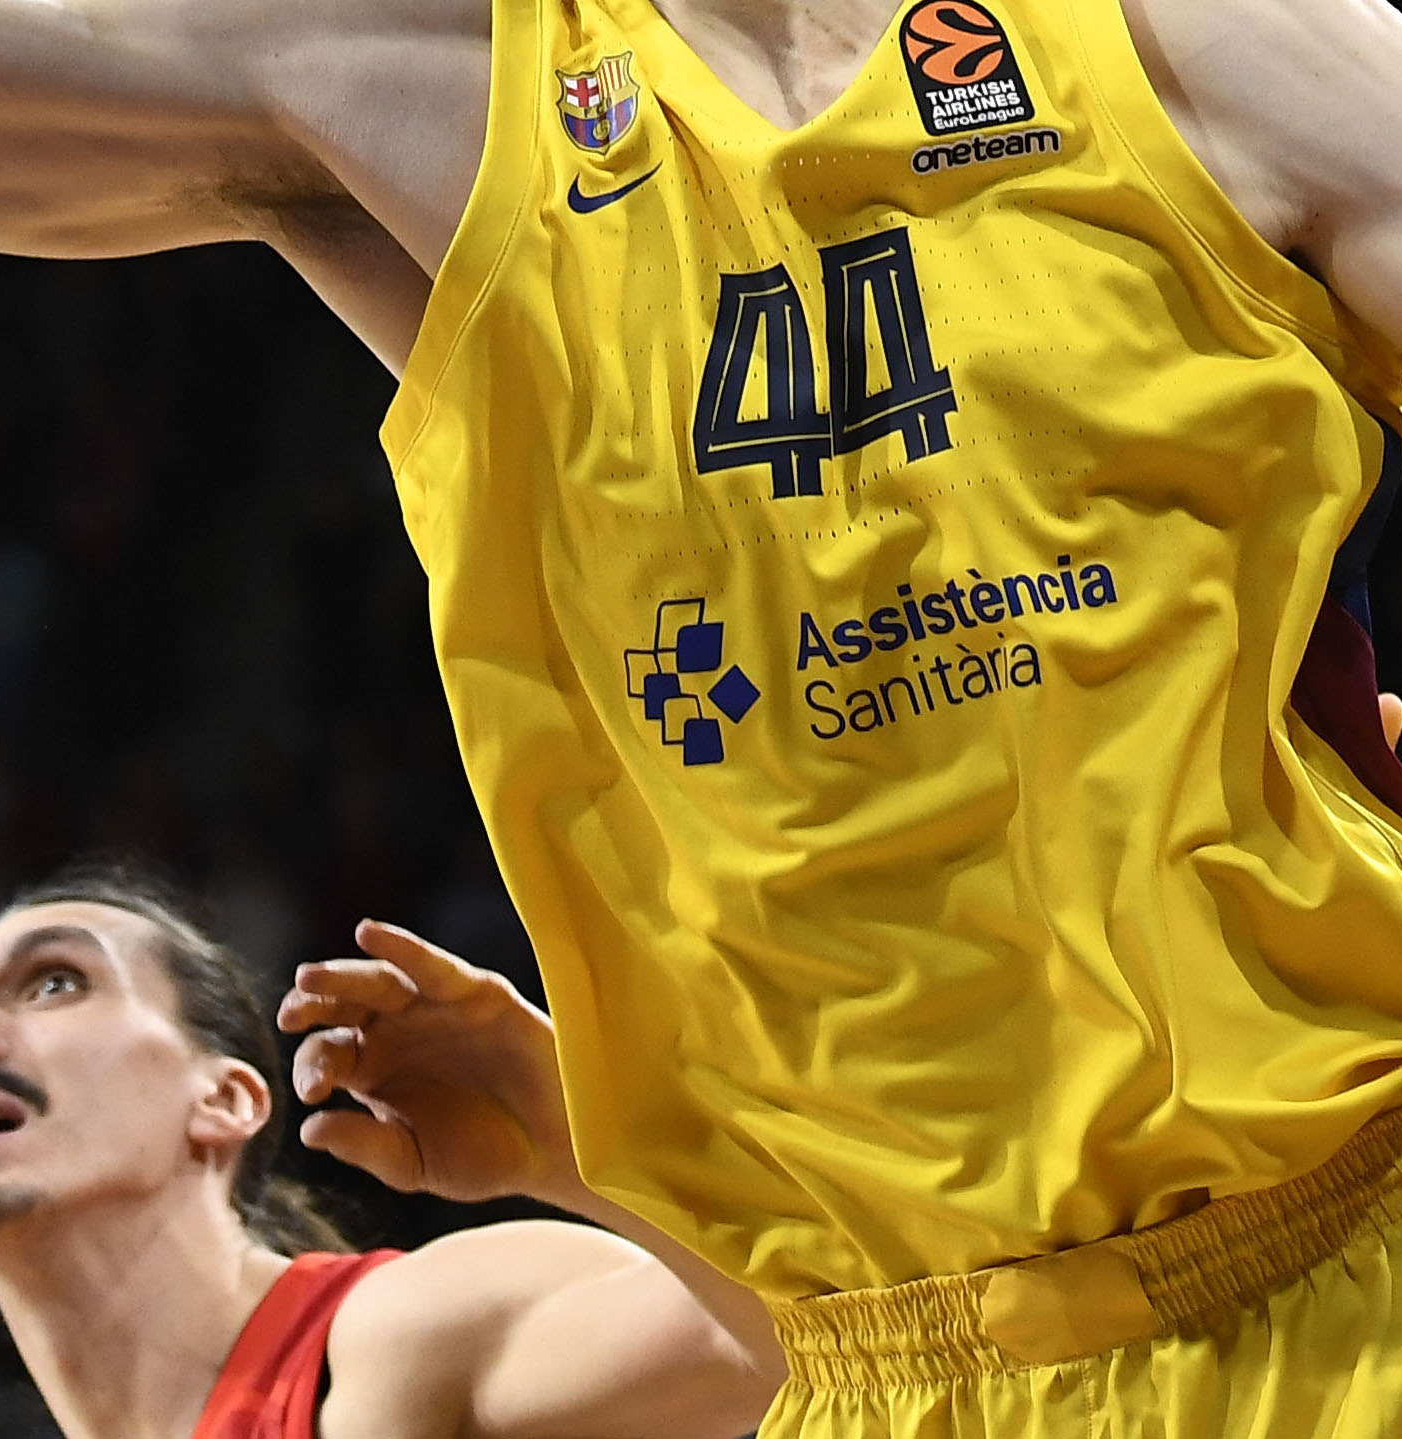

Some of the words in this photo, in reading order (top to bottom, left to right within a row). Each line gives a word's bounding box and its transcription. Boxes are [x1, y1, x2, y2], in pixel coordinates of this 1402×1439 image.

[925, 78, 1017, 106] TURKISH
[932, 92, 1022, 120] AIRLINES
[933, 106, 1026, 131] EuroLeague
[912, 130, 1060, 174] oneteam
[692, 225, 958, 499] 44
[796, 554, 1119, 671] Assistència
[804, 632, 1043, 740] Sanitària
